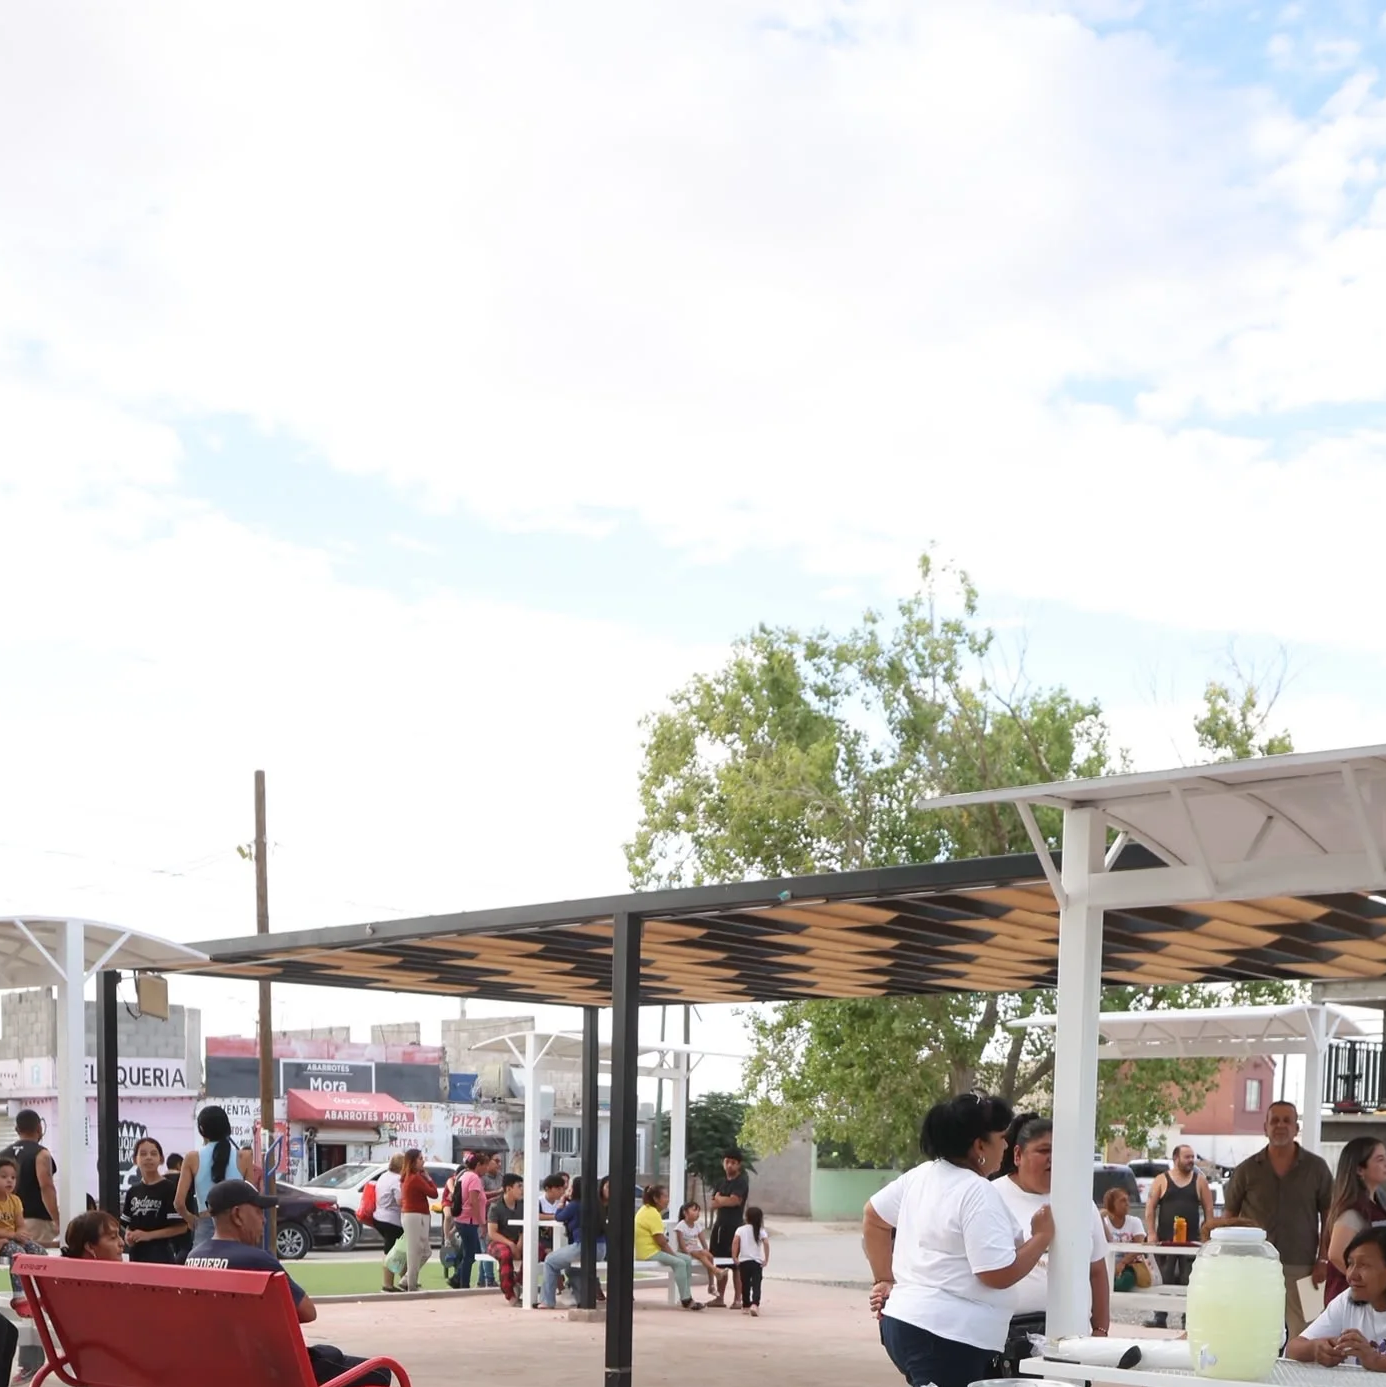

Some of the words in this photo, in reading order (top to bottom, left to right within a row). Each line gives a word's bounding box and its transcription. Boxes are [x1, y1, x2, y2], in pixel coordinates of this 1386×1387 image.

[307, 1063, 350, 1073] ABARROTES
[309, 1076, 347, 1092] Mora
[324, 1110, 378, 1121] ABARROTES
[382, 1111, 408, 1122] MORA
[451, 1114, 493, 1128] PIZZA
[395, 1122, 433, 1133] ONELESS
